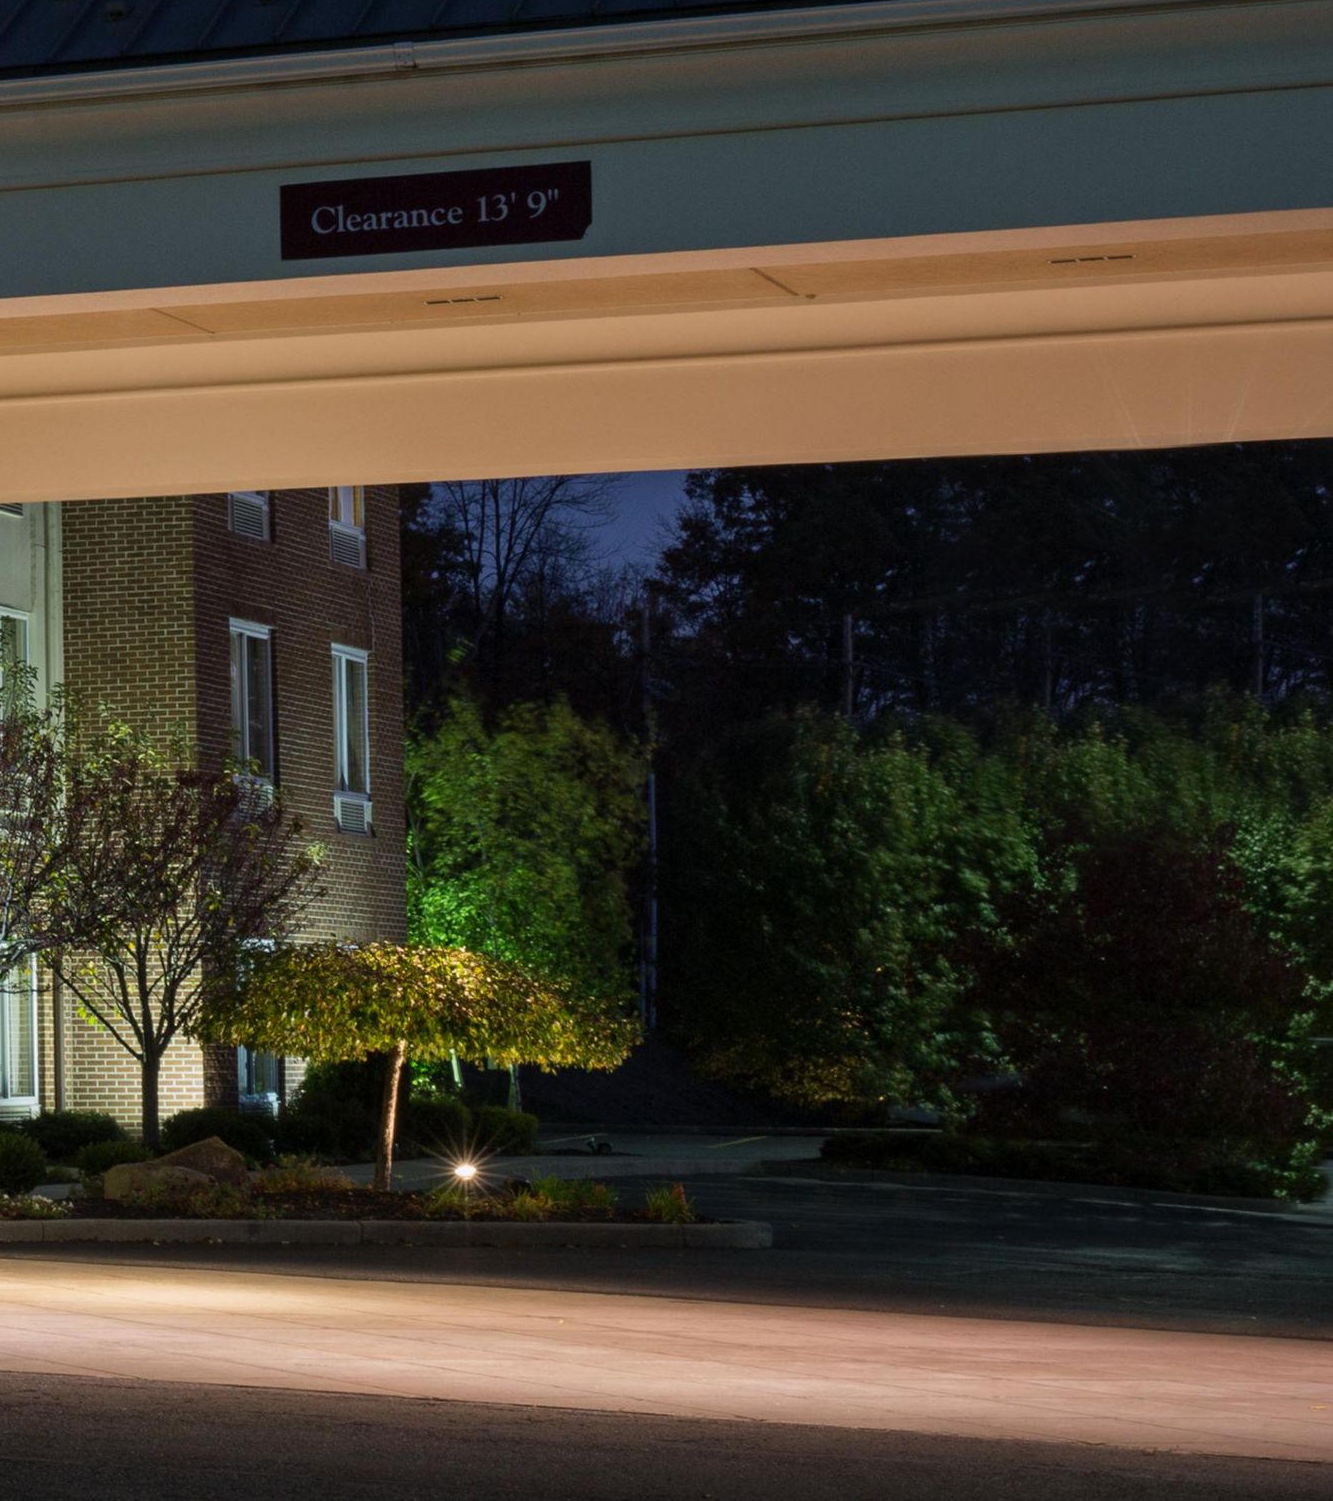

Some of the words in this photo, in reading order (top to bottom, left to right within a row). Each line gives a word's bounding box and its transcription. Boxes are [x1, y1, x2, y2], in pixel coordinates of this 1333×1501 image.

[310, 204, 464, 234] Clearance
[476, 191, 518, 223] 13'
[527, 187, 560, 219] 9"
